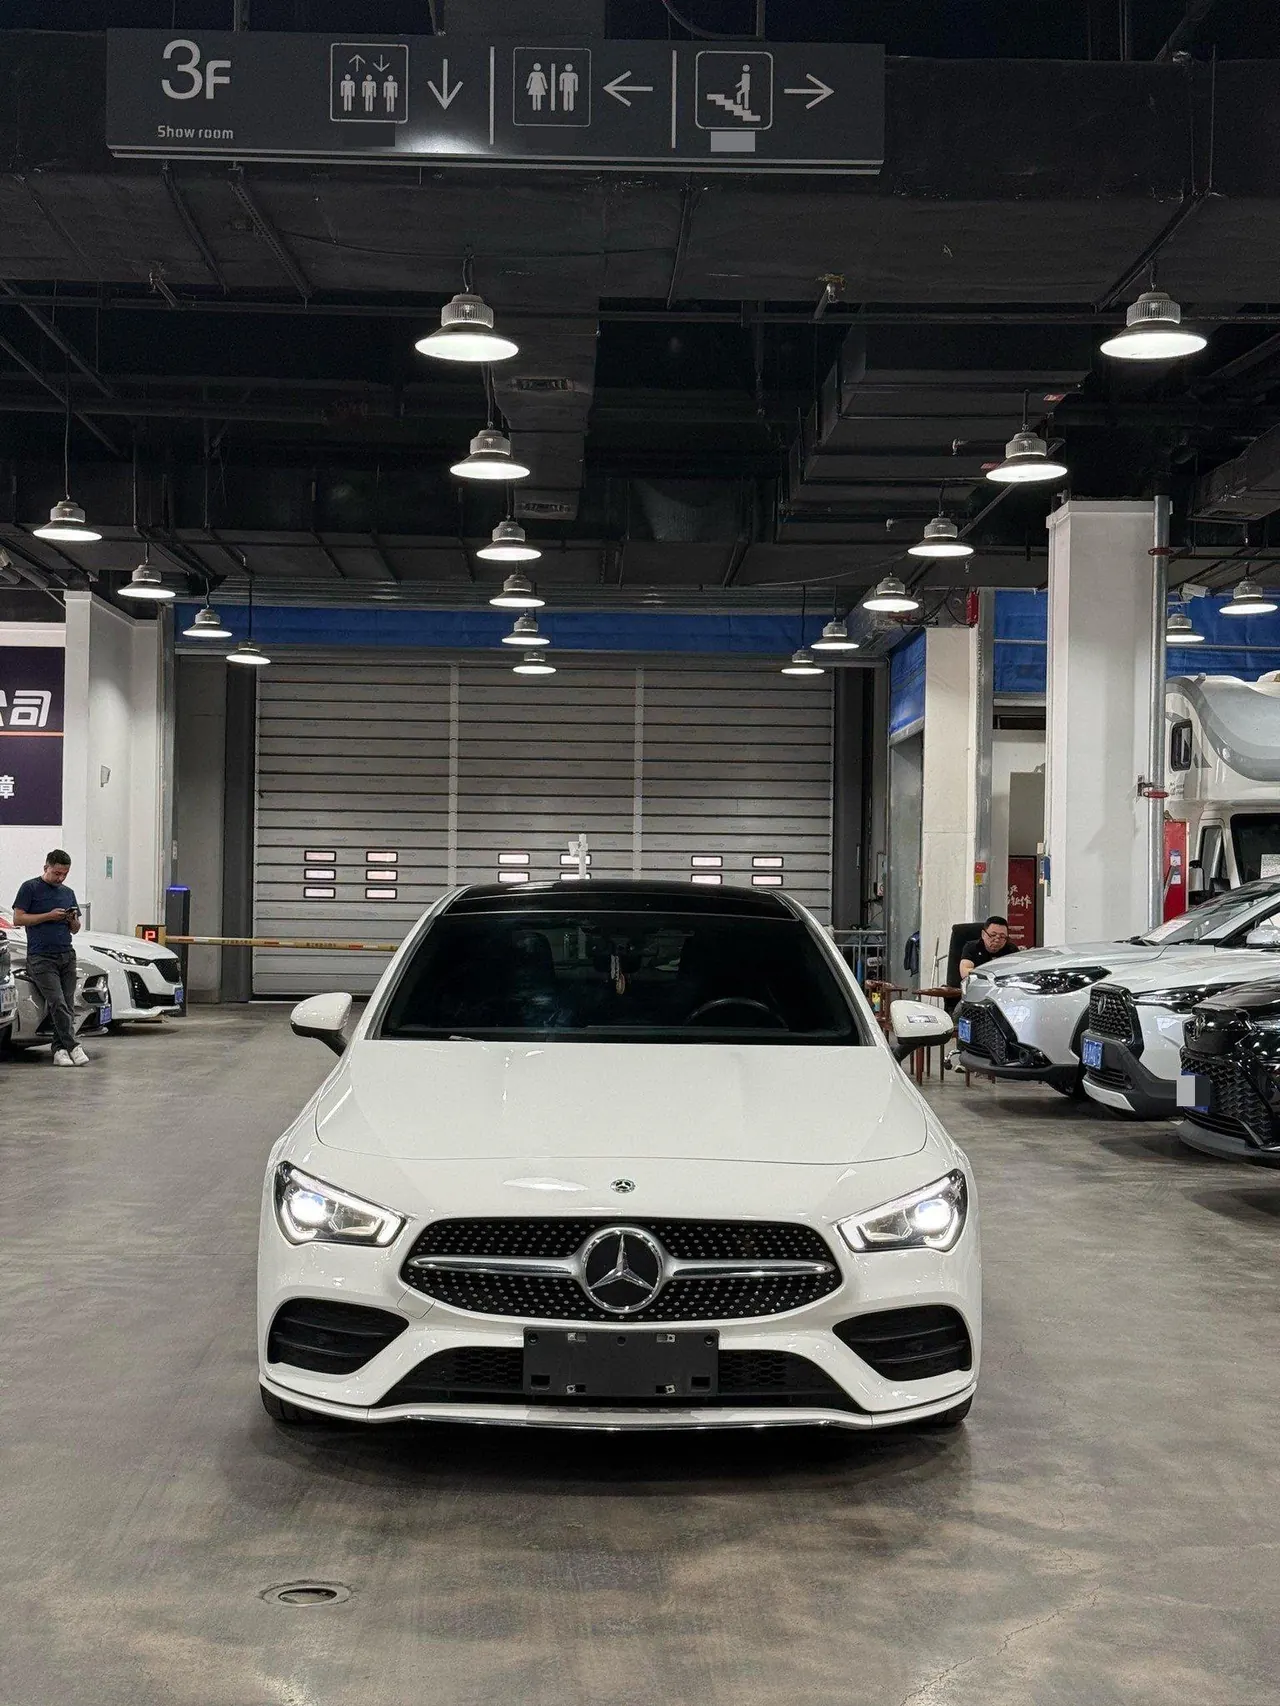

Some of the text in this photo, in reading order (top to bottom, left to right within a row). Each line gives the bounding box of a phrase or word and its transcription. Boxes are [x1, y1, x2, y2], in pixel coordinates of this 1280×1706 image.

[161, 39, 232, 99] 3F
[157, 125, 234, 139] Show room
[0, 690, 52, 727] 司
